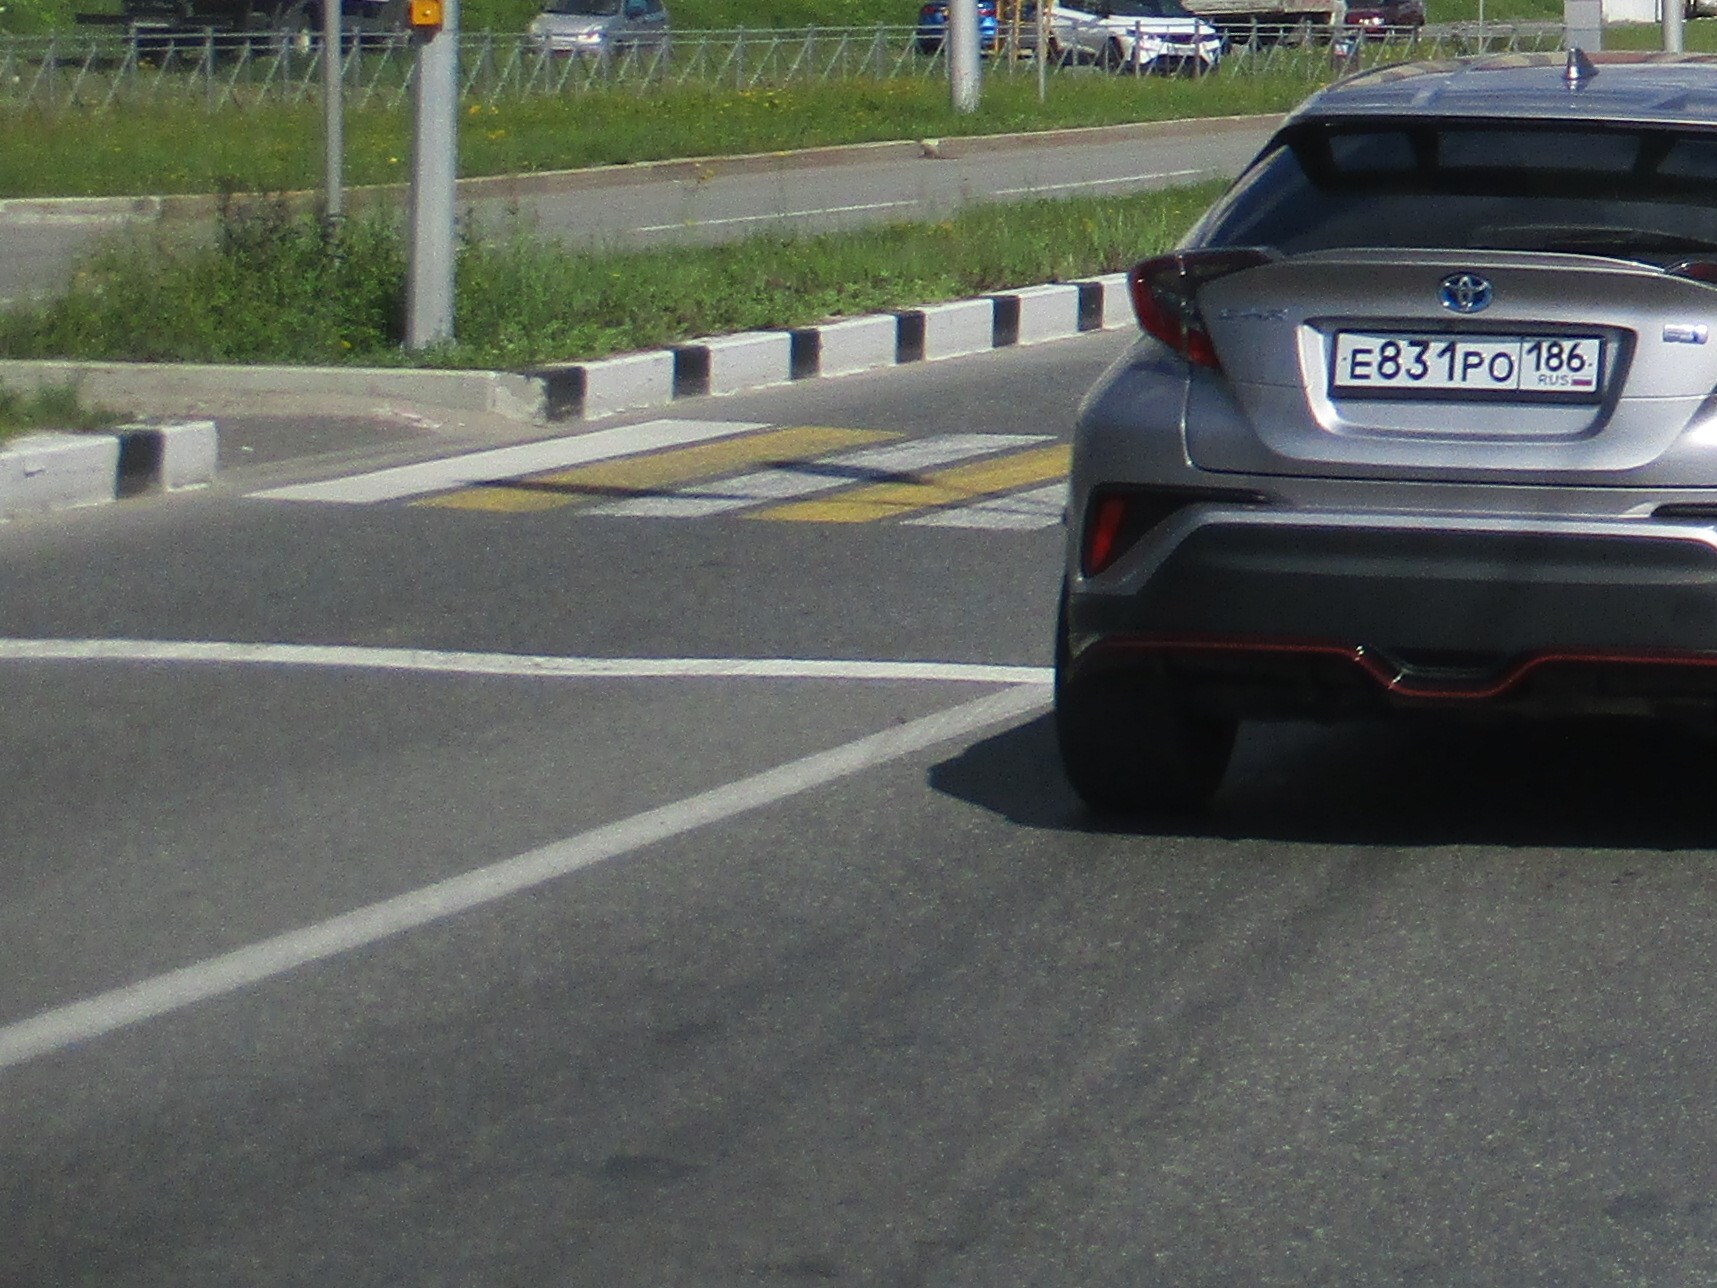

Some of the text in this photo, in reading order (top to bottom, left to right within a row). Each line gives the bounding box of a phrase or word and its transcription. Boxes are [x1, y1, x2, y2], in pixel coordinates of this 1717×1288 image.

[1350, 340, 1587, 382] Е831РО 186
[1539, 375, 1570, 386] RUS
